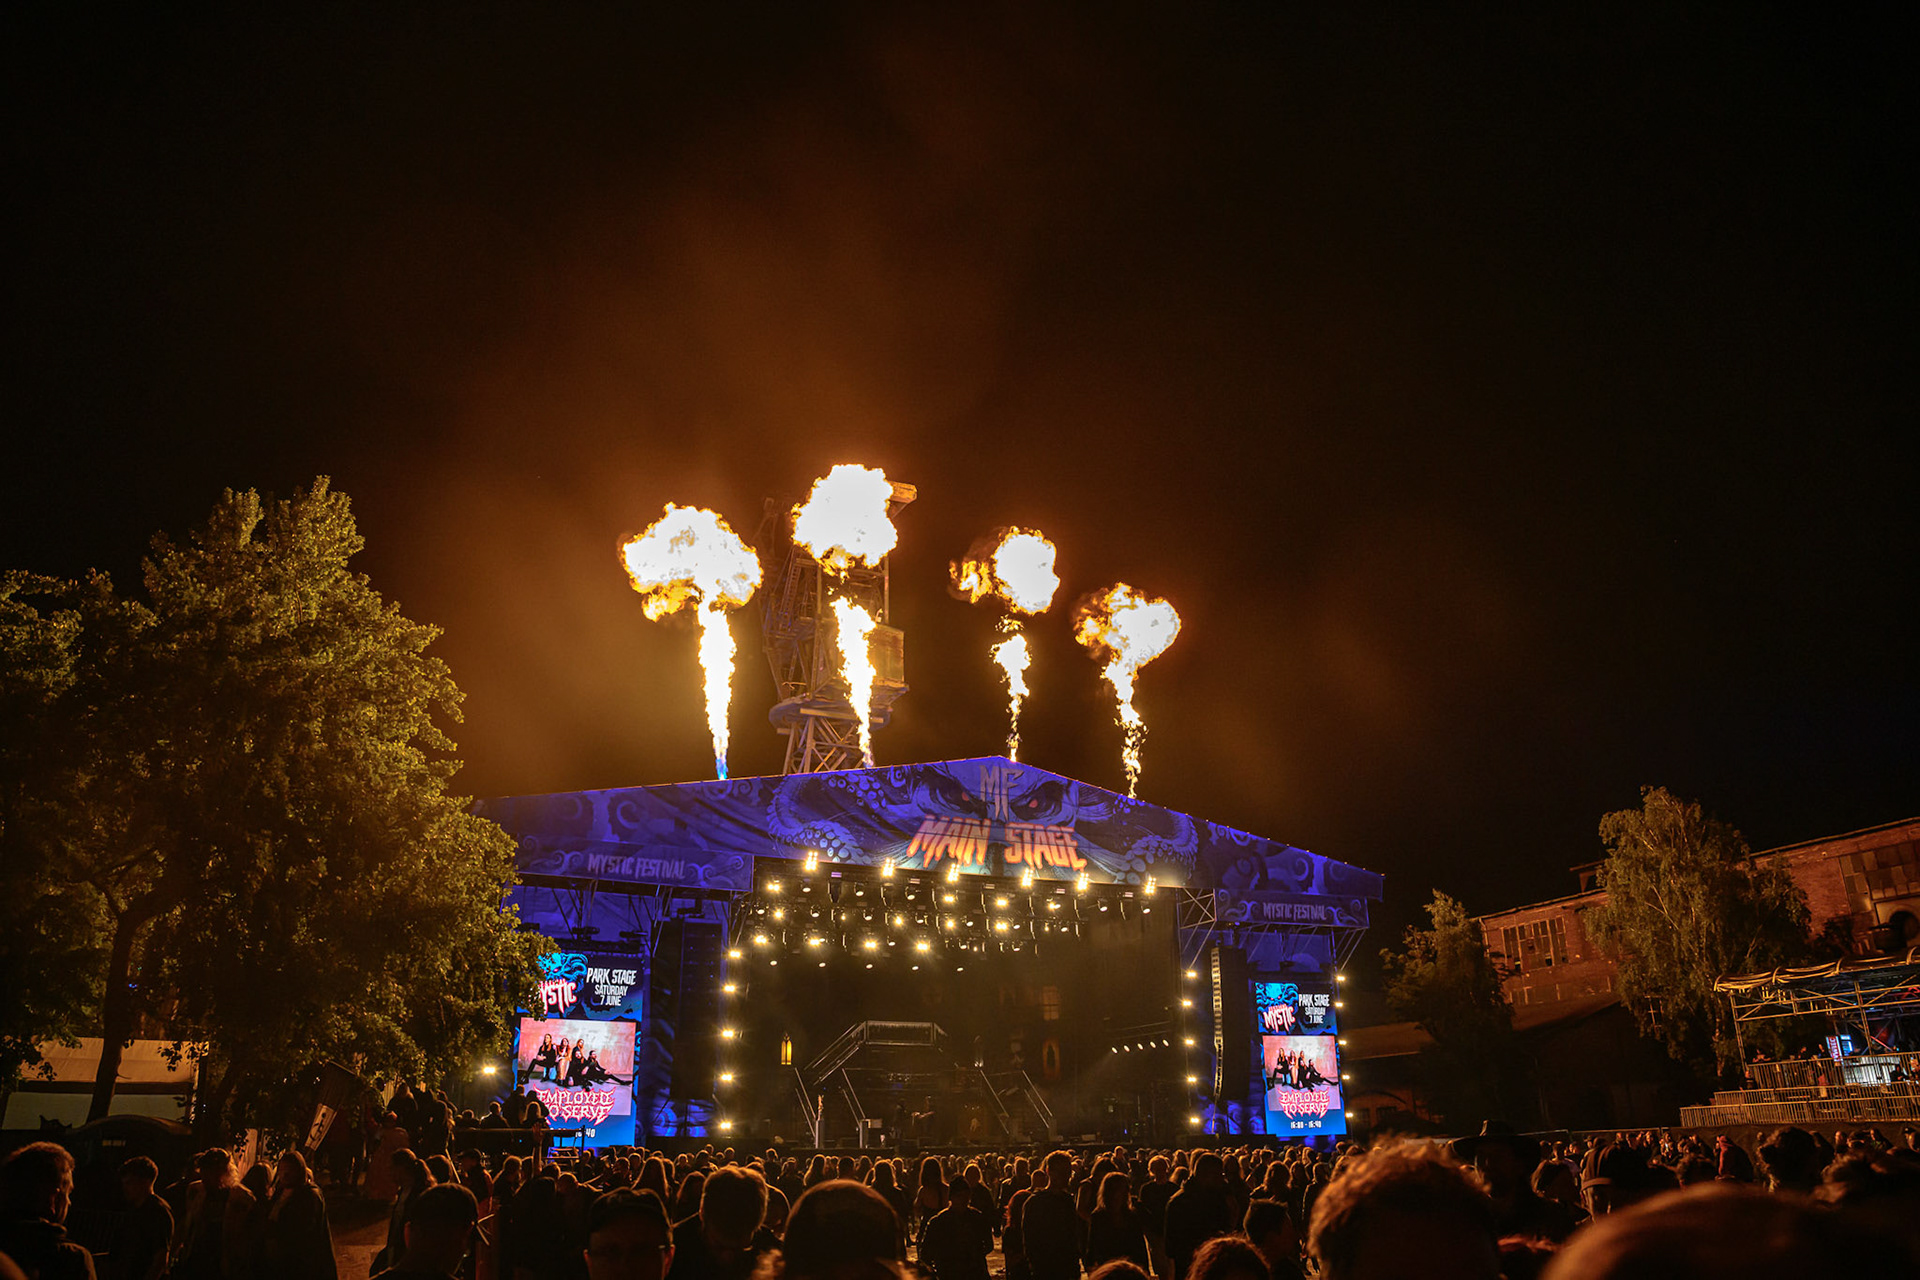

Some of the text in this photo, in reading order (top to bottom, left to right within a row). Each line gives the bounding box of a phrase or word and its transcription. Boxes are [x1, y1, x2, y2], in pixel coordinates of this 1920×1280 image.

[980, 765, 1024, 822] MF
[906, 813, 1087, 872] MAIN STAGE
[587, 853, 686, 880] MYSTIC FESTIVAL
[1262, 902, 1327, 921] MYSTIC FESTIVAL
[586, 967, 611, 985] PARK
[611, 969, 638, 986] STAGE
[594, 984, 628, 997] SATURDAY
[600, 995, 622, 1006] 7 JUNE
[1298, 994, 1314, 1008] PARK
[1313, 994, 1330, 1007] STAGE
[1263, 1004, 1296, 1033] MYSTIC
[533, 1084, 616, 1107] EMPLOYED
[1277, 1087, 1331, 1104] EMPLOYED
[561, 1100, 615, 1126] SERVE
[1280, 1100, 1331, 1120] TO SERVE
